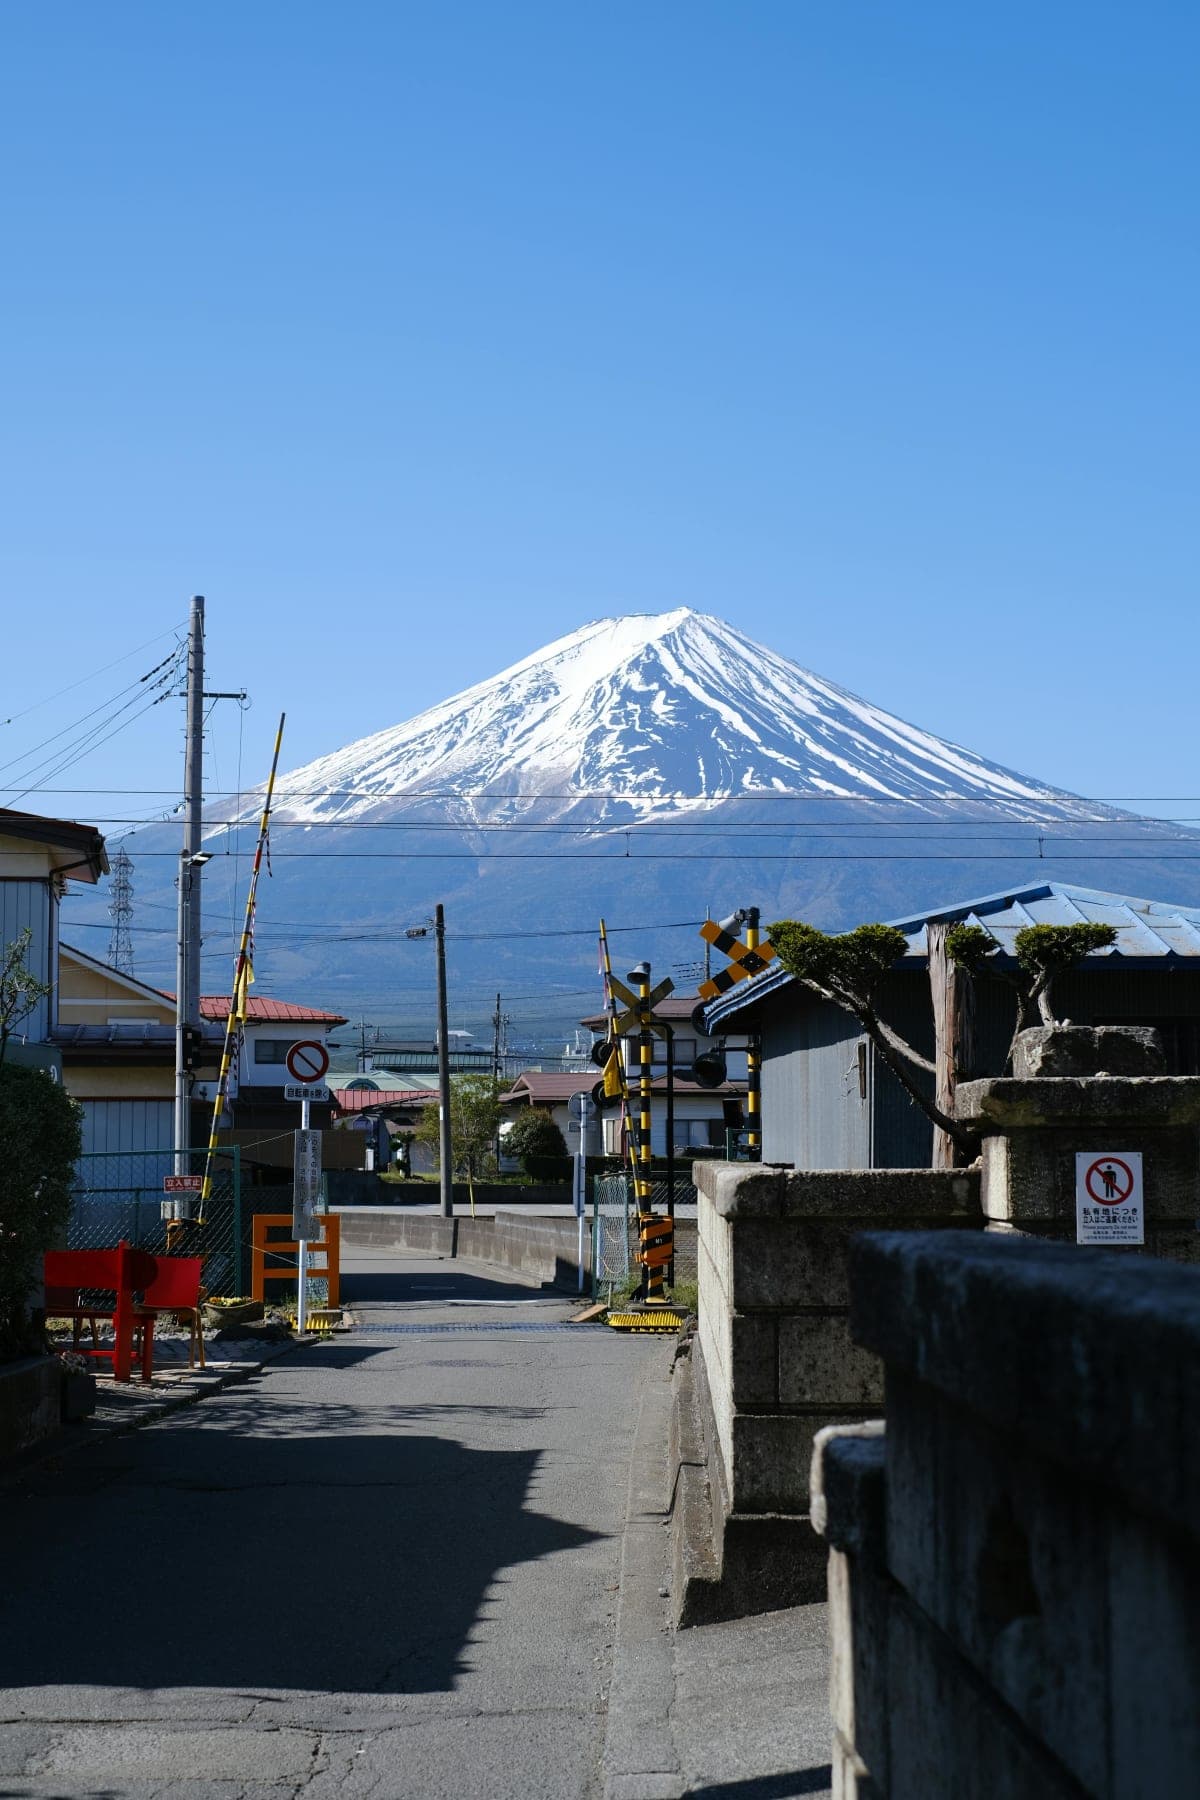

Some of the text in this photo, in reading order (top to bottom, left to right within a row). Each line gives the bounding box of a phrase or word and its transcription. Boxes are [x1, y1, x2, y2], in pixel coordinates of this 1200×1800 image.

[287, 1088, 327, 1097] 自転車を除く
[166, 1178, 200, 1187] 立入禁止
[1083, 1207, 1138, 1216] 私有地につき
[1082, 1215, 1138, 1224] 立入はご遠慮ください
